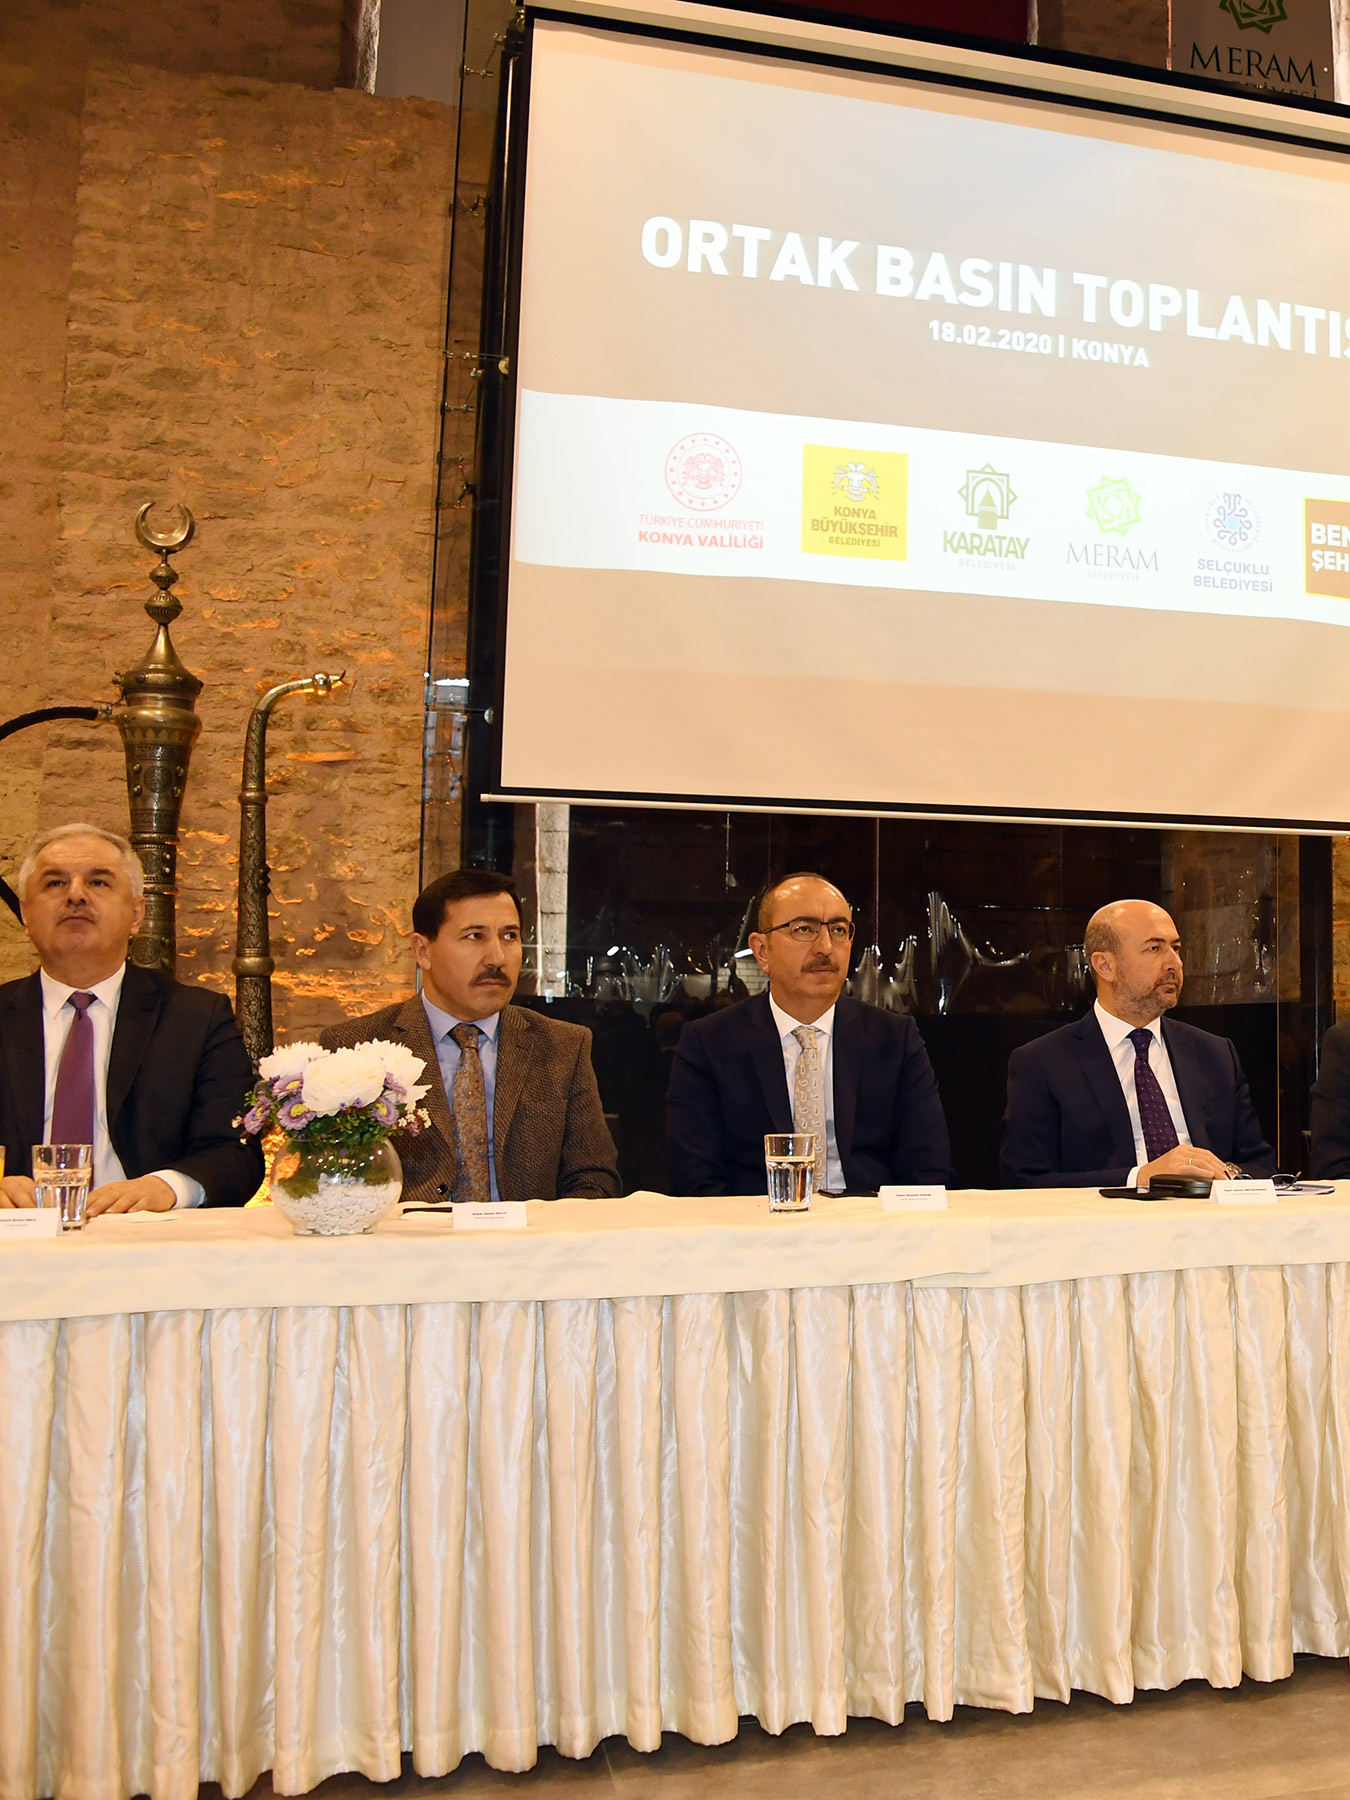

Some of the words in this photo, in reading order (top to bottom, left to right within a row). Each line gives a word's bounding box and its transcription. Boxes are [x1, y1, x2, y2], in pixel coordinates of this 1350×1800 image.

[1190, 41, 1317, 87] MERAM
[641, 215, 860, 292] ORTAK
[876, 244, 1057, 318] BASIN
[928, 319, 1053, 355] 18.02.2020
[1072, 337, 1150, 368] KONYA
[638, 513, 686, 528] TÜRKİYE
[687, 516, 765, 532] CUMHURİYETİ
[833, 505, 877, 521] KONYA
[811, 516, 899, 538] BÜYÜKŞEHİR
[638, 530, 694, 547] KONYA
[697, 533, 764, 550] VALİLİĞİ
[828, 535, 881, 548] BELEDİYESİ
[943, 530, 1031, 560] KARATAY
[1066, 541, 1160, 572] MERAM
[1197, 558, 1270, 576] SELÇUKLU
[1193, 575, 1273, 593] BELEDİYESİ
